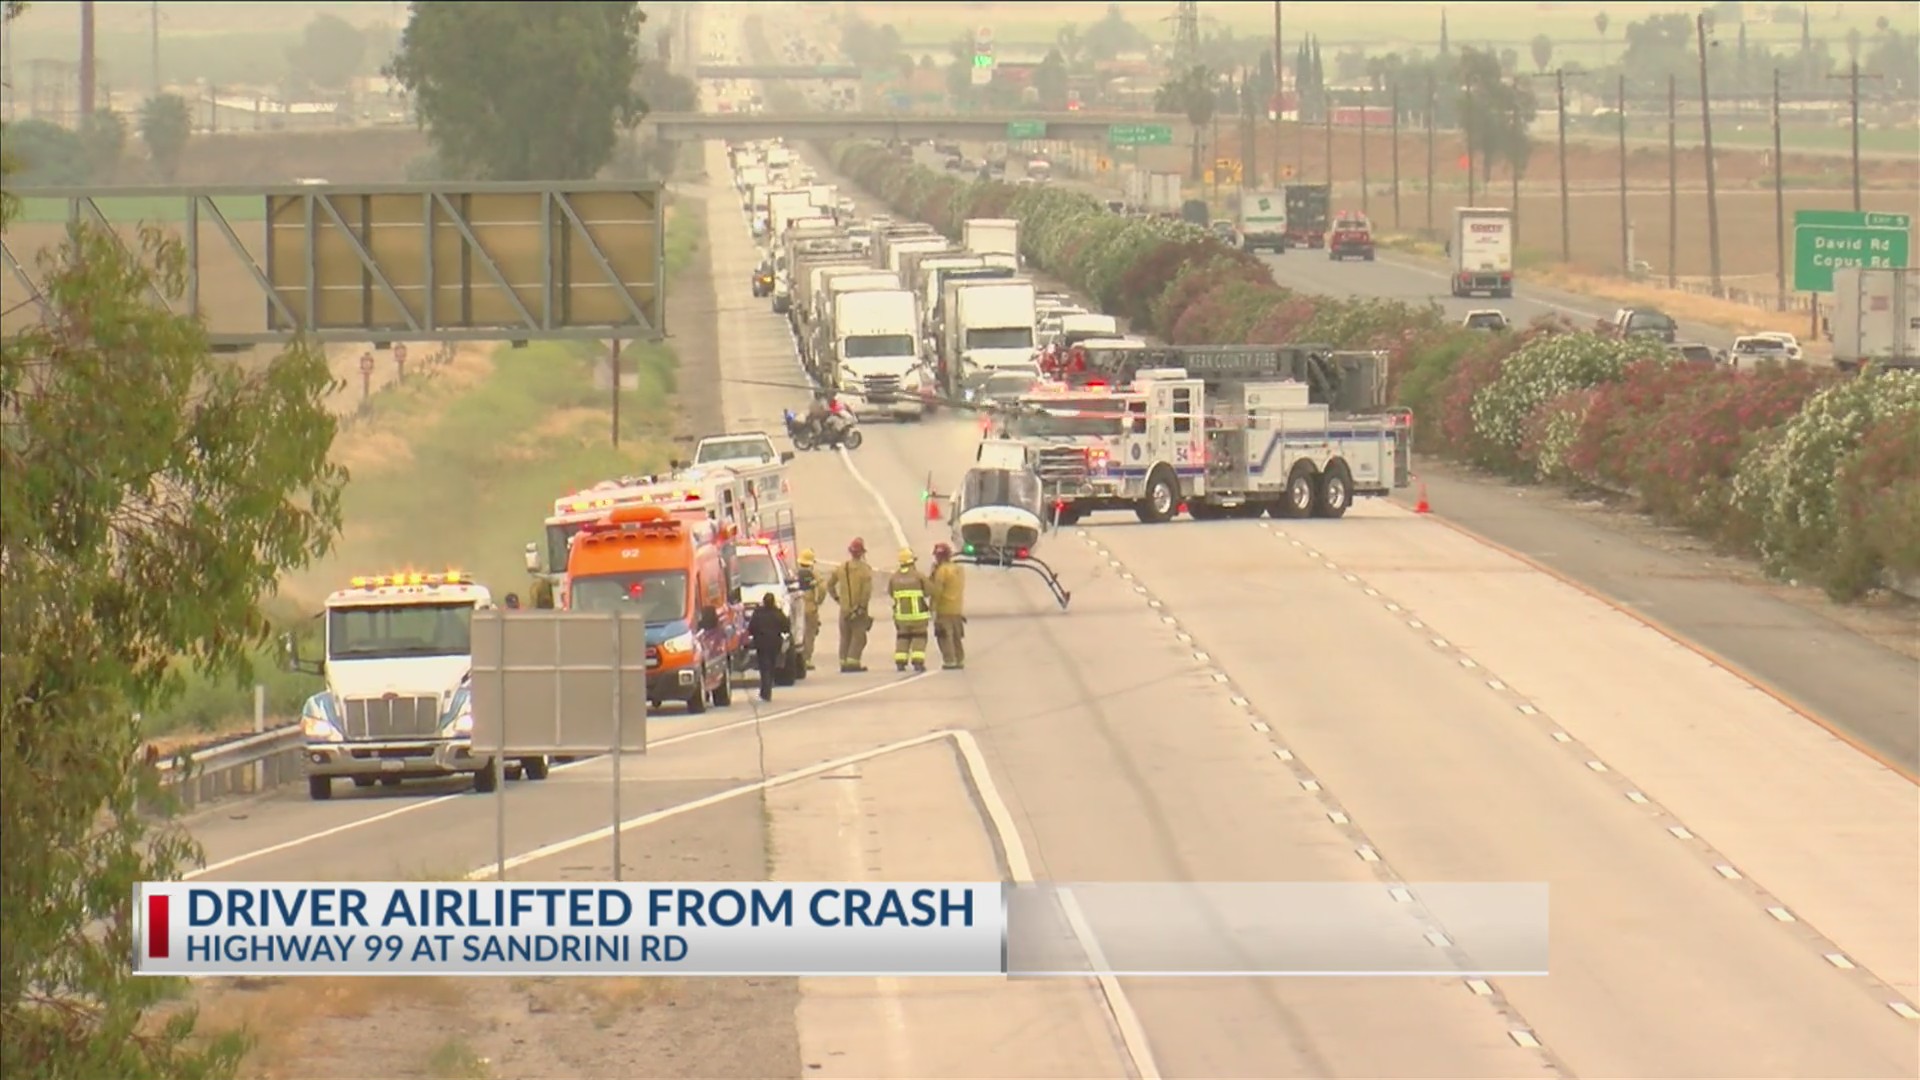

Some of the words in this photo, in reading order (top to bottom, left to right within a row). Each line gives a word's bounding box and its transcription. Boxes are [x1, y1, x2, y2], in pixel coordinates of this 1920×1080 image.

[1815, 237, 1862, 250] David
[1870, 238, 1890, 251] Rd
[1813, 254, 1863, 269] Copus
[1870, 255, 1890, 268] Rd
[1215, 353, 1252, 368] COUNTY
[1255, 352, 1277, 367] FIRE
[1176, 447, 1188, 461] 54
[621, 548, 640, 558] 92
